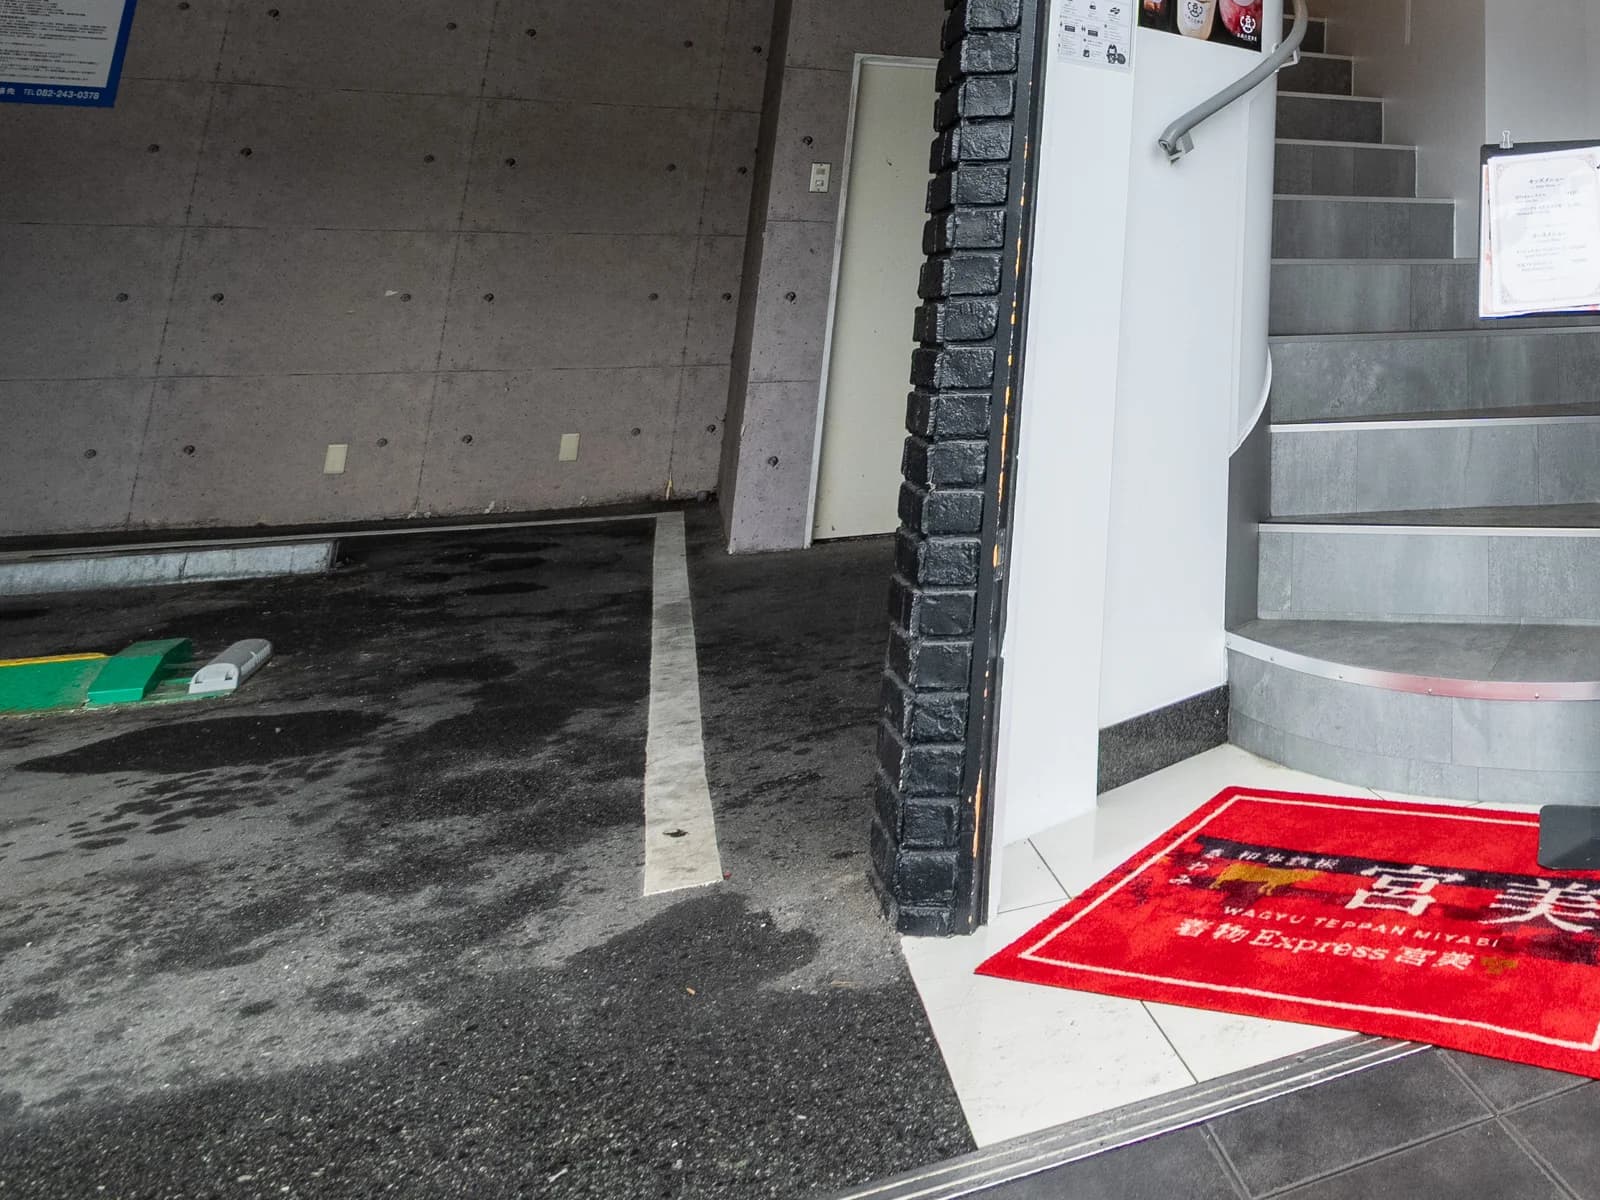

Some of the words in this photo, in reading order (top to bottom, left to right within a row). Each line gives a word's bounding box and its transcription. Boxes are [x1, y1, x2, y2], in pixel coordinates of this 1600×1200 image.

[36, 88, 101, 100] 082-243-0378
[1223, 906, 1306, 924] WAGYU
[1313, 917, 1407, 936] TEPPAN
[1413, 930, 1499, 948] MIYABI
